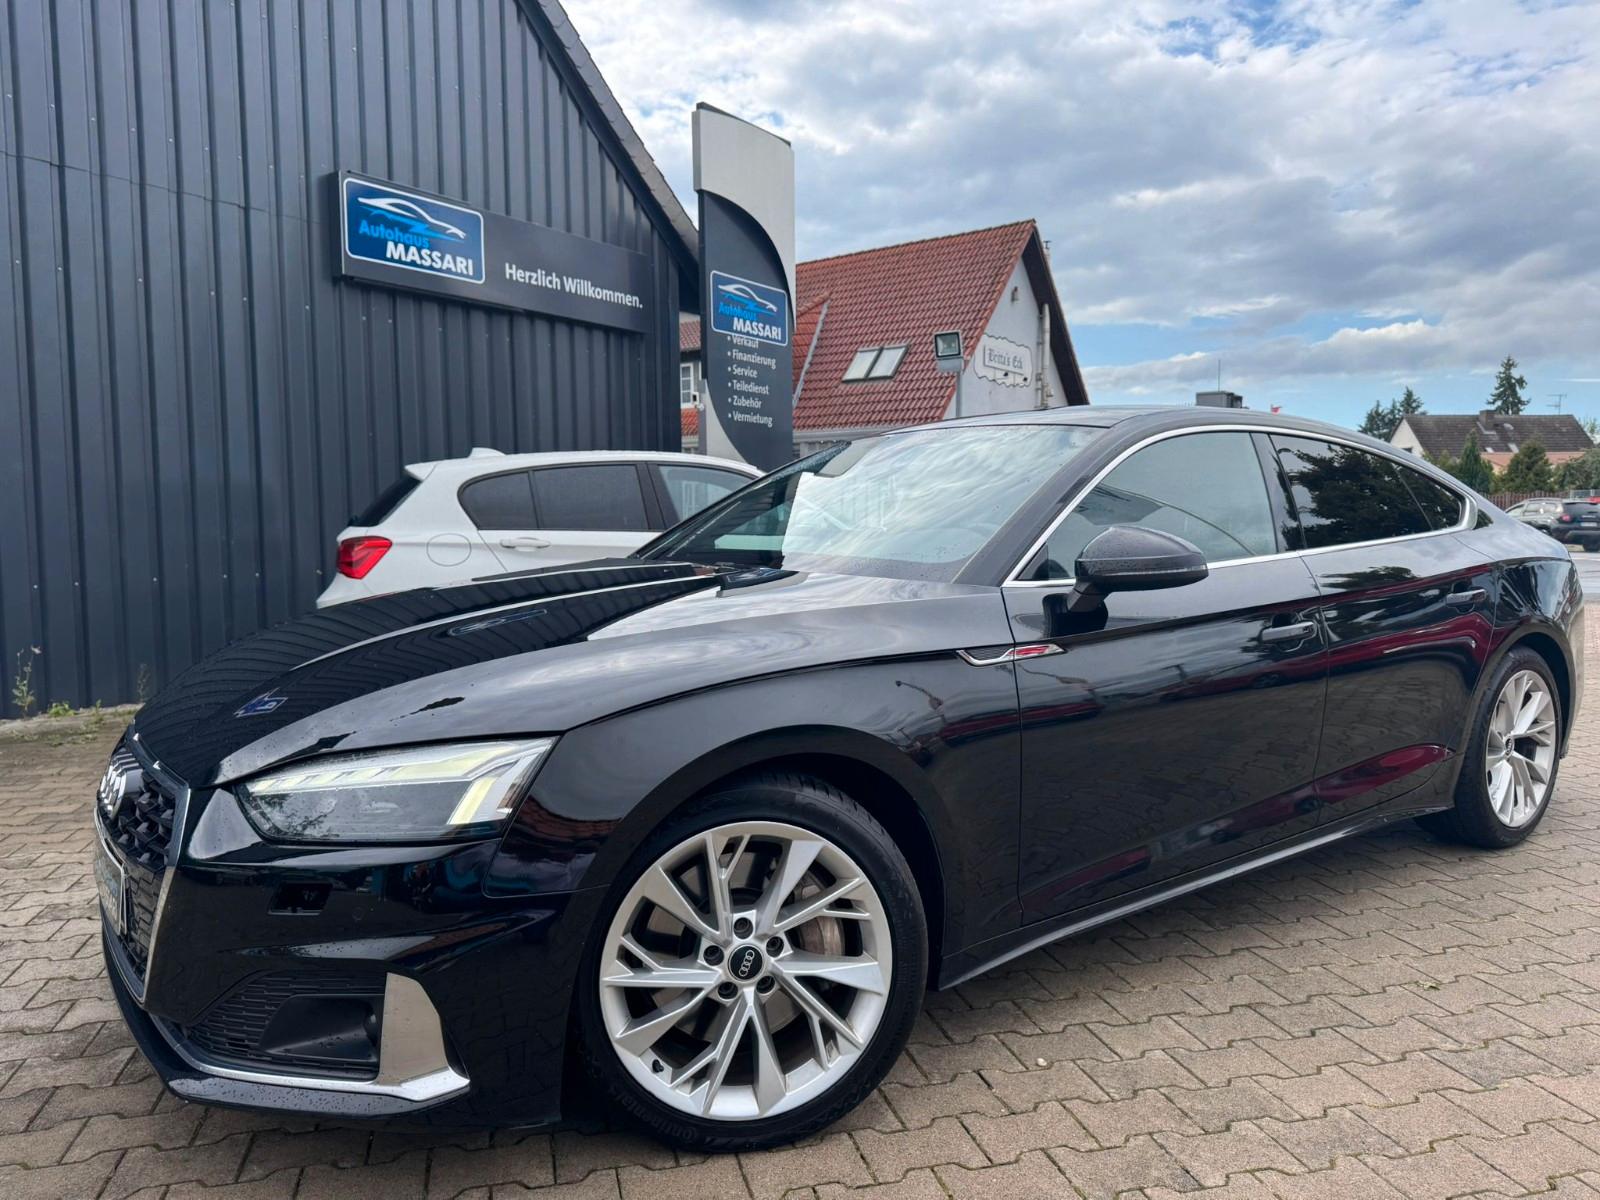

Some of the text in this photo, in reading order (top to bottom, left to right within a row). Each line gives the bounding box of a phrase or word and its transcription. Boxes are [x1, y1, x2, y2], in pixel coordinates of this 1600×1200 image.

[358, 219, 430, 249] Autohaus
[386, 240, 474, 276] MASSARI
[505, 262, 643, 308] Herzlich Willkommen.
[733, 317, 782, 341] MASSARI
[732, 349, 776, 370] Finanzierung
[732, 364, 758, 378] Service
[732, 379, 769, 395] Teiledienst
[733, 395, 762, 409] Zubehör
[732, 410, 773, 428] Vermietung
